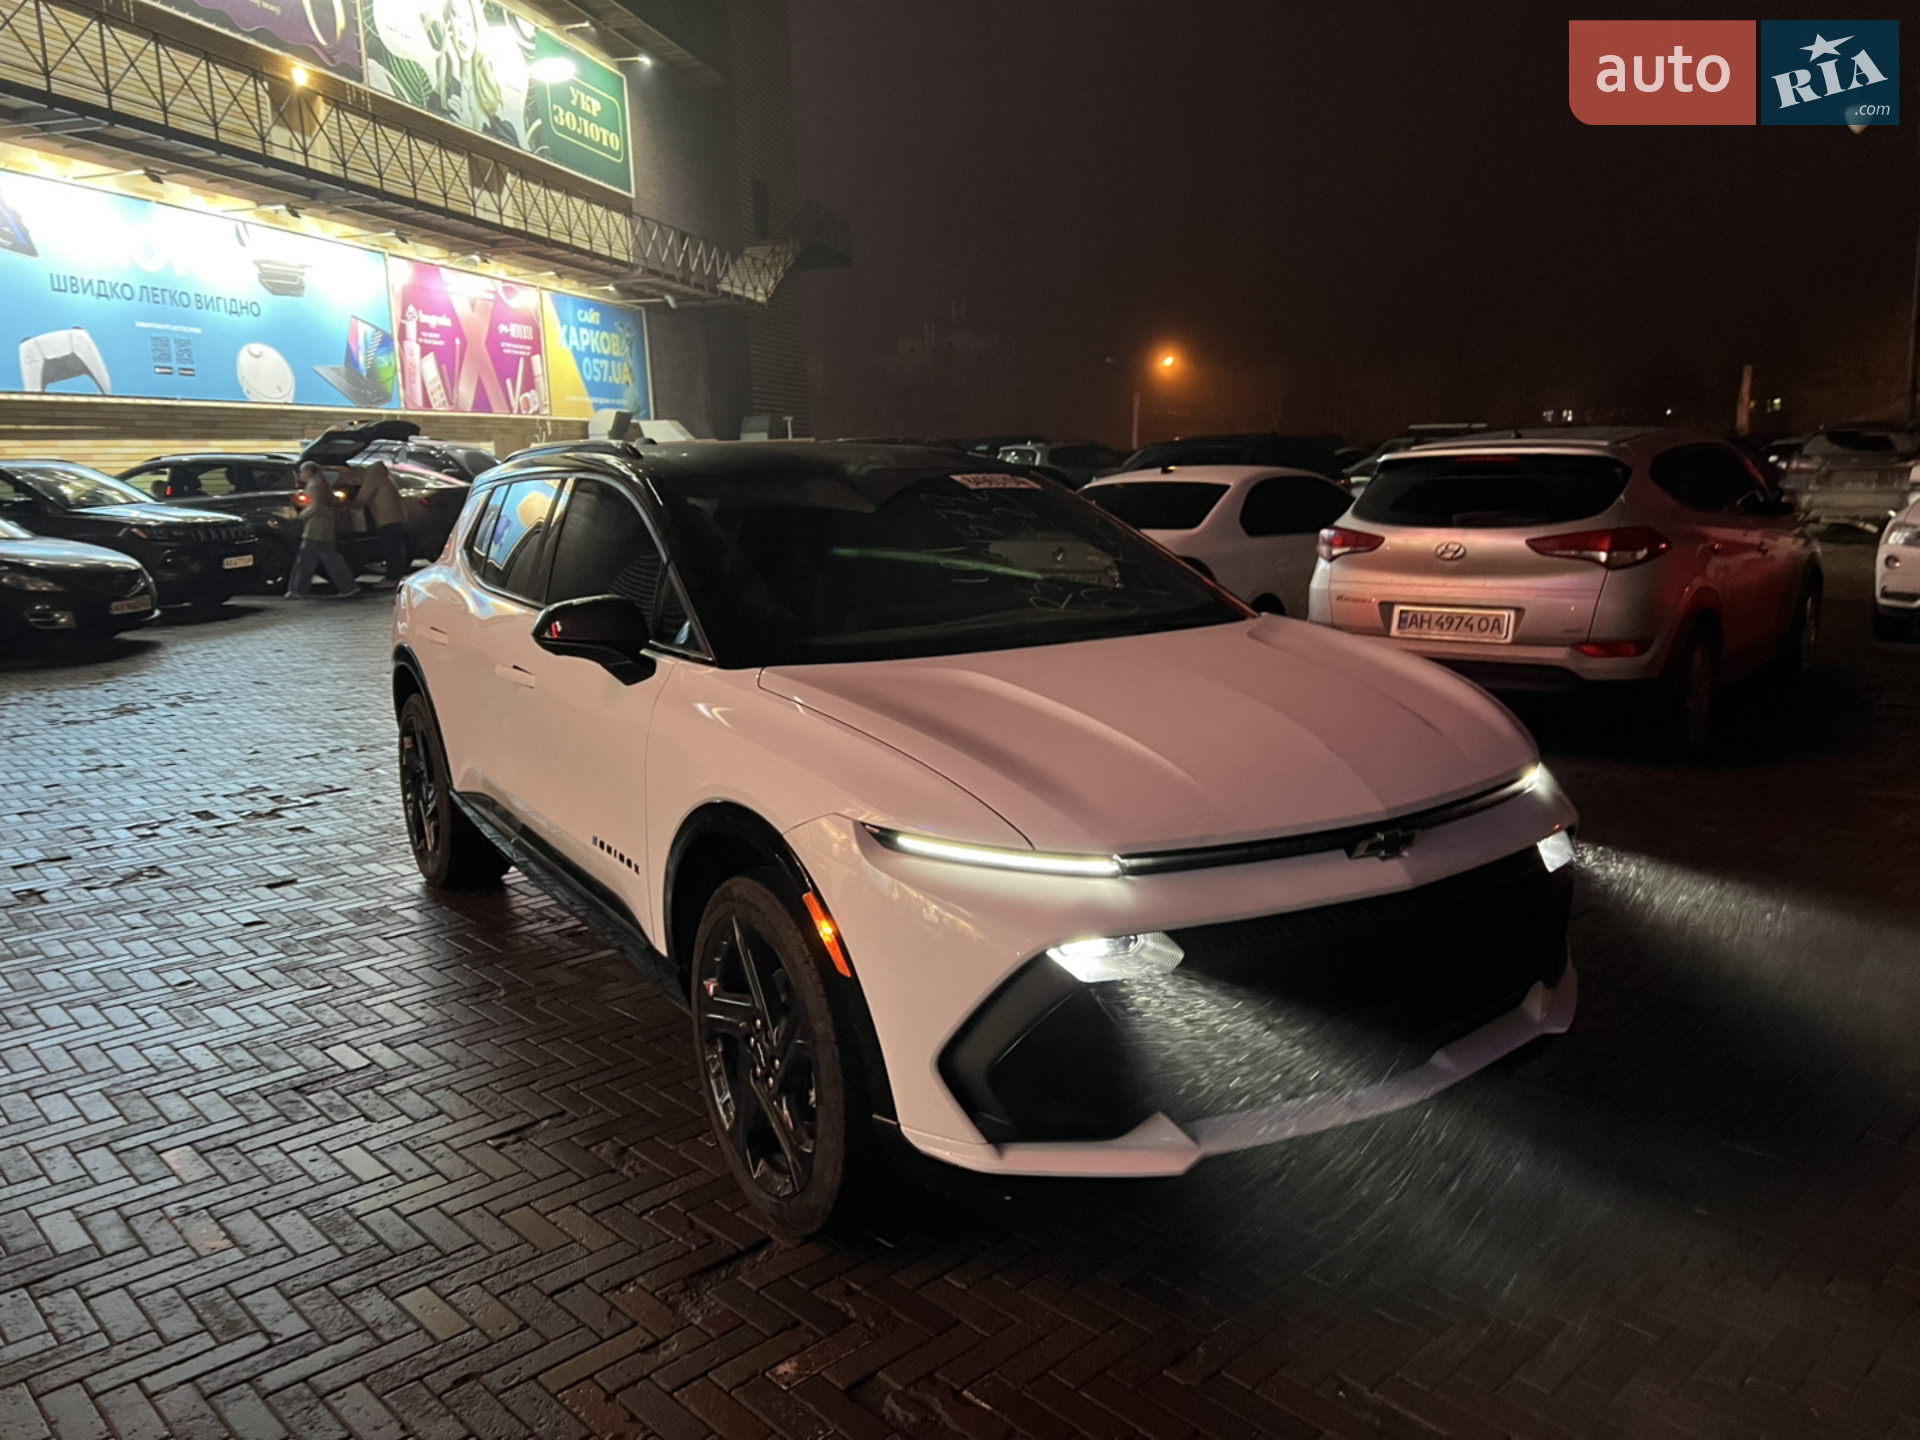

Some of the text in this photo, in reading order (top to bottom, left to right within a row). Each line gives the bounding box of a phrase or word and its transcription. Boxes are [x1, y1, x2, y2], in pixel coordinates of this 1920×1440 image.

[569, 86, 602, 117] УКР
[552, 104, 621, 152] ЗОЛОТО
[49, 272, 261, 318] ШВИДКО ЛЕГКО ВИГІДНО
[582, 356, 633, 385] 057.UA
[1435, 614, 1474, 633] 4974
